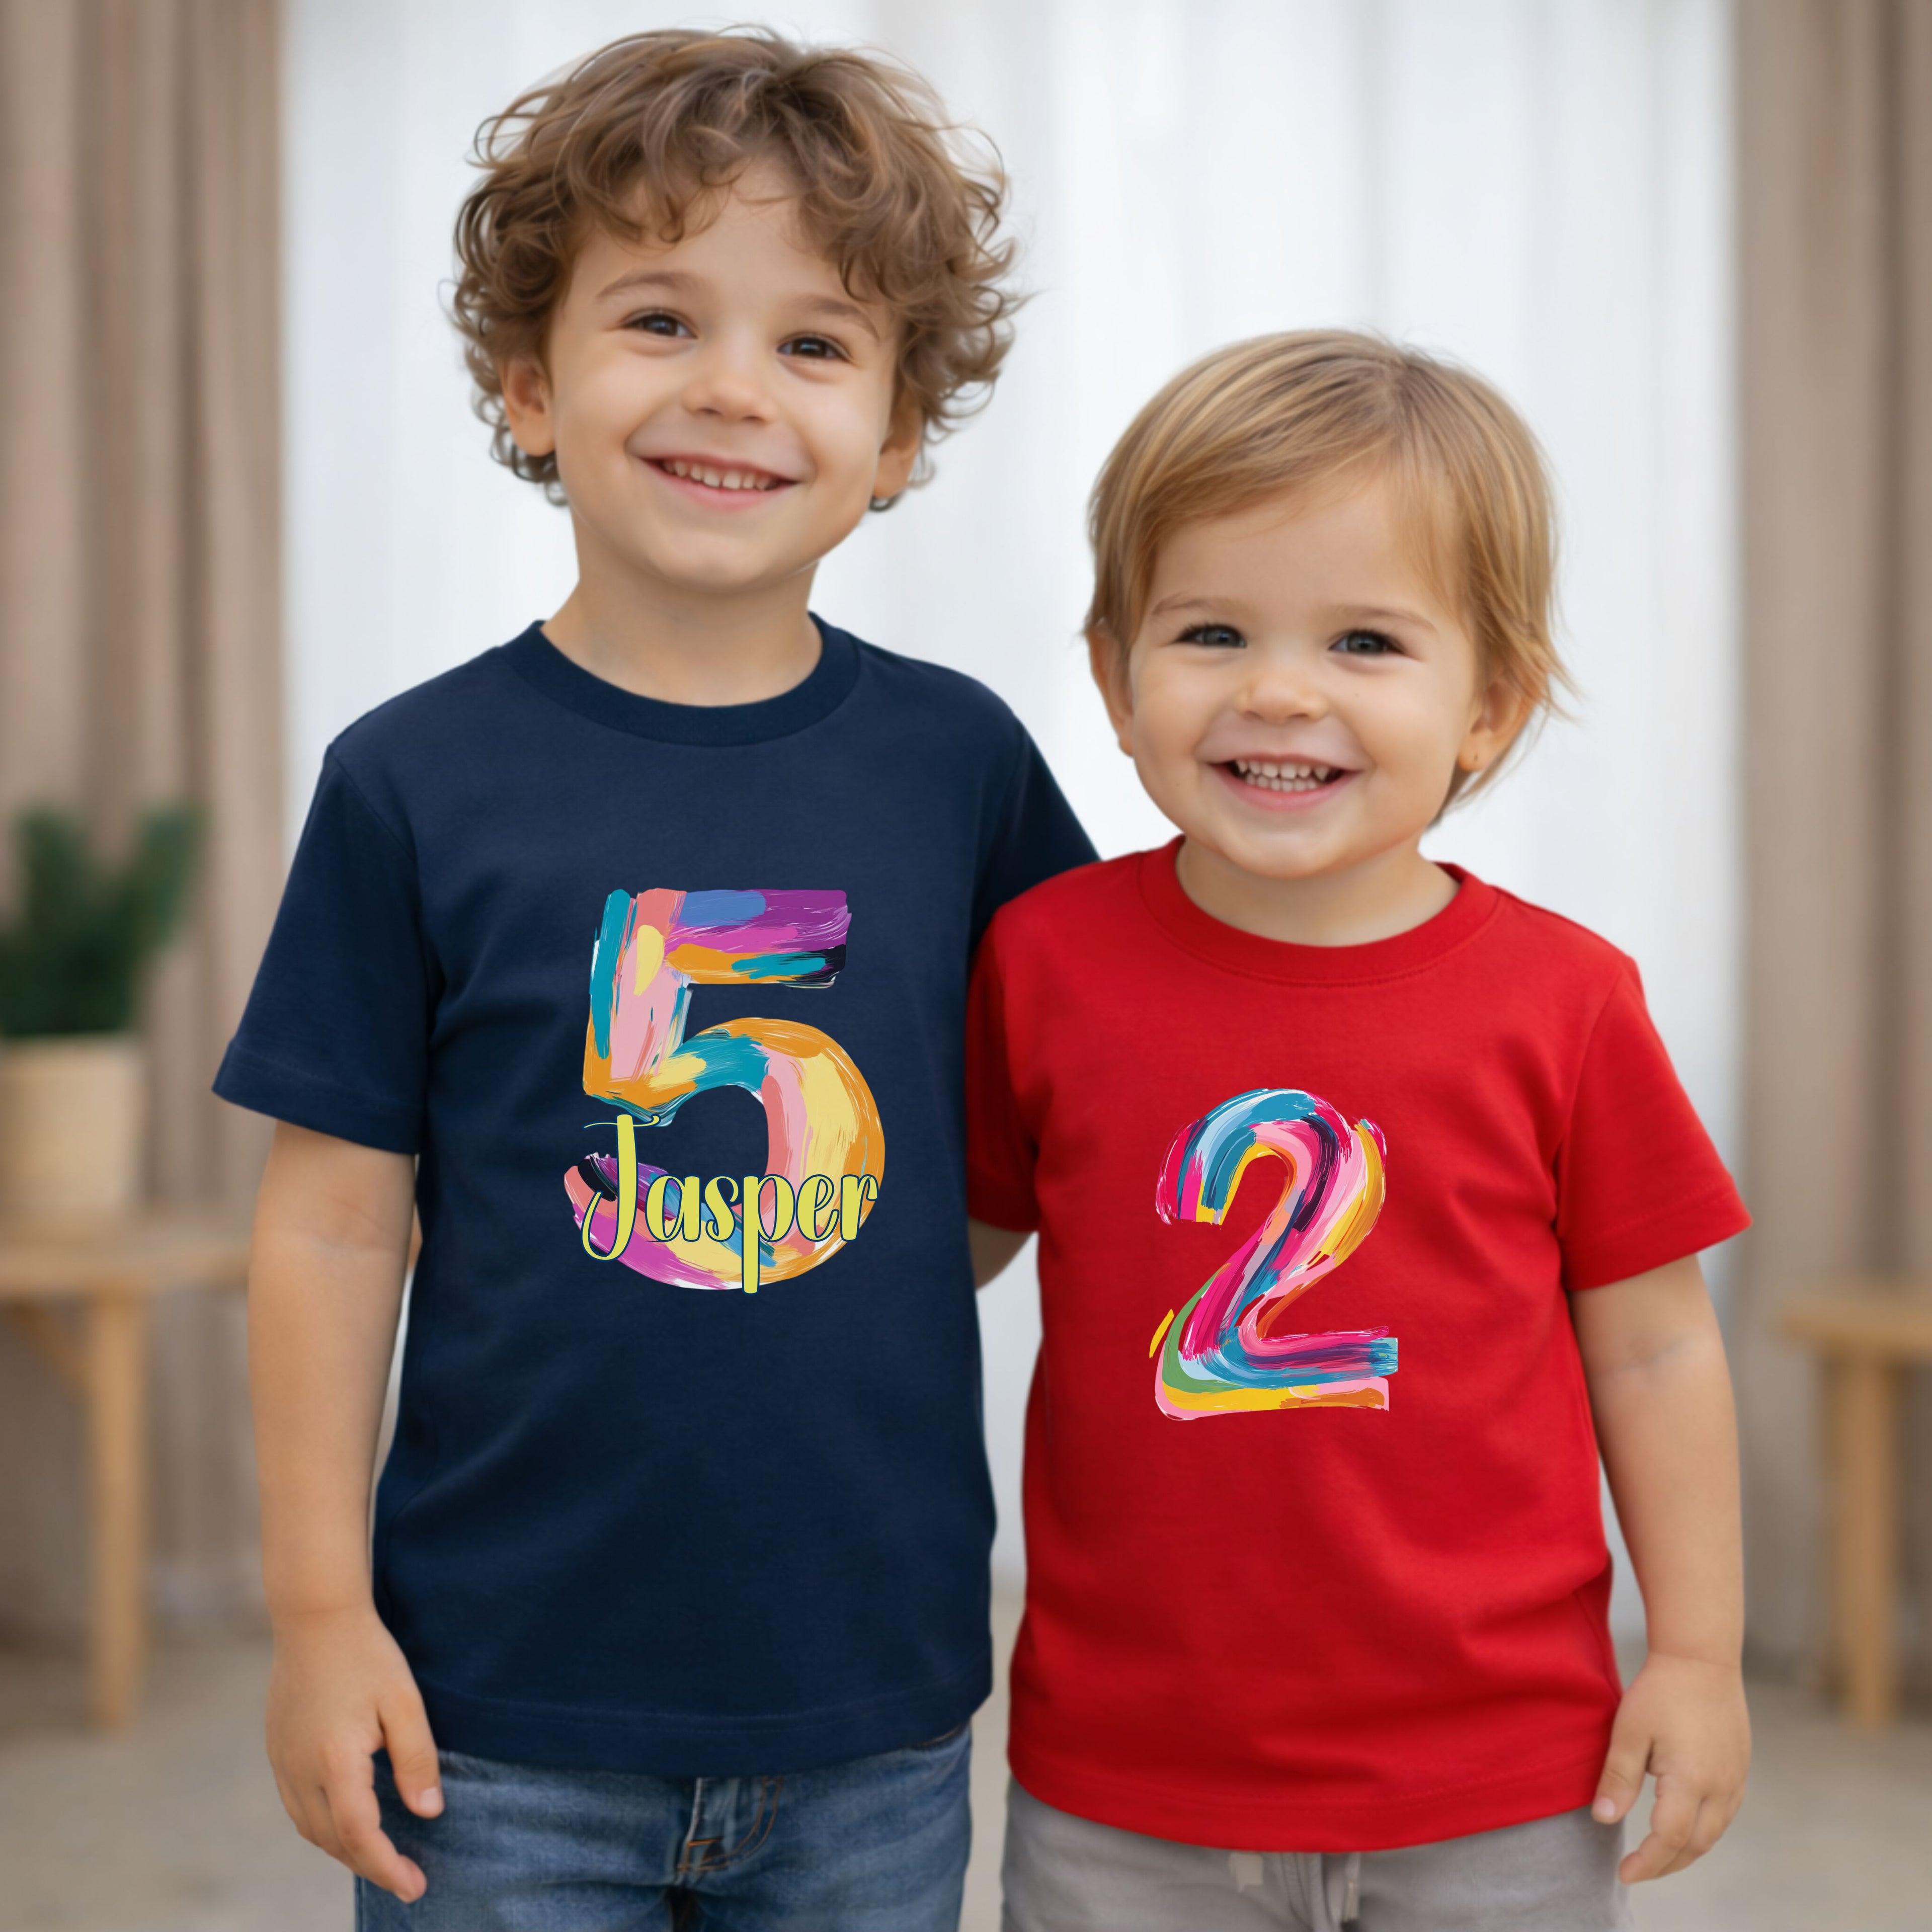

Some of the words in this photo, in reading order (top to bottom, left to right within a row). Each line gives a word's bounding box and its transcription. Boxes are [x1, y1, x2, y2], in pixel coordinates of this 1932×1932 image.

[564, 888, 886, 1290] 5
[581, 1113, 879, 1295] Jasper
[1149, 1088, 1398, 1421] 2
